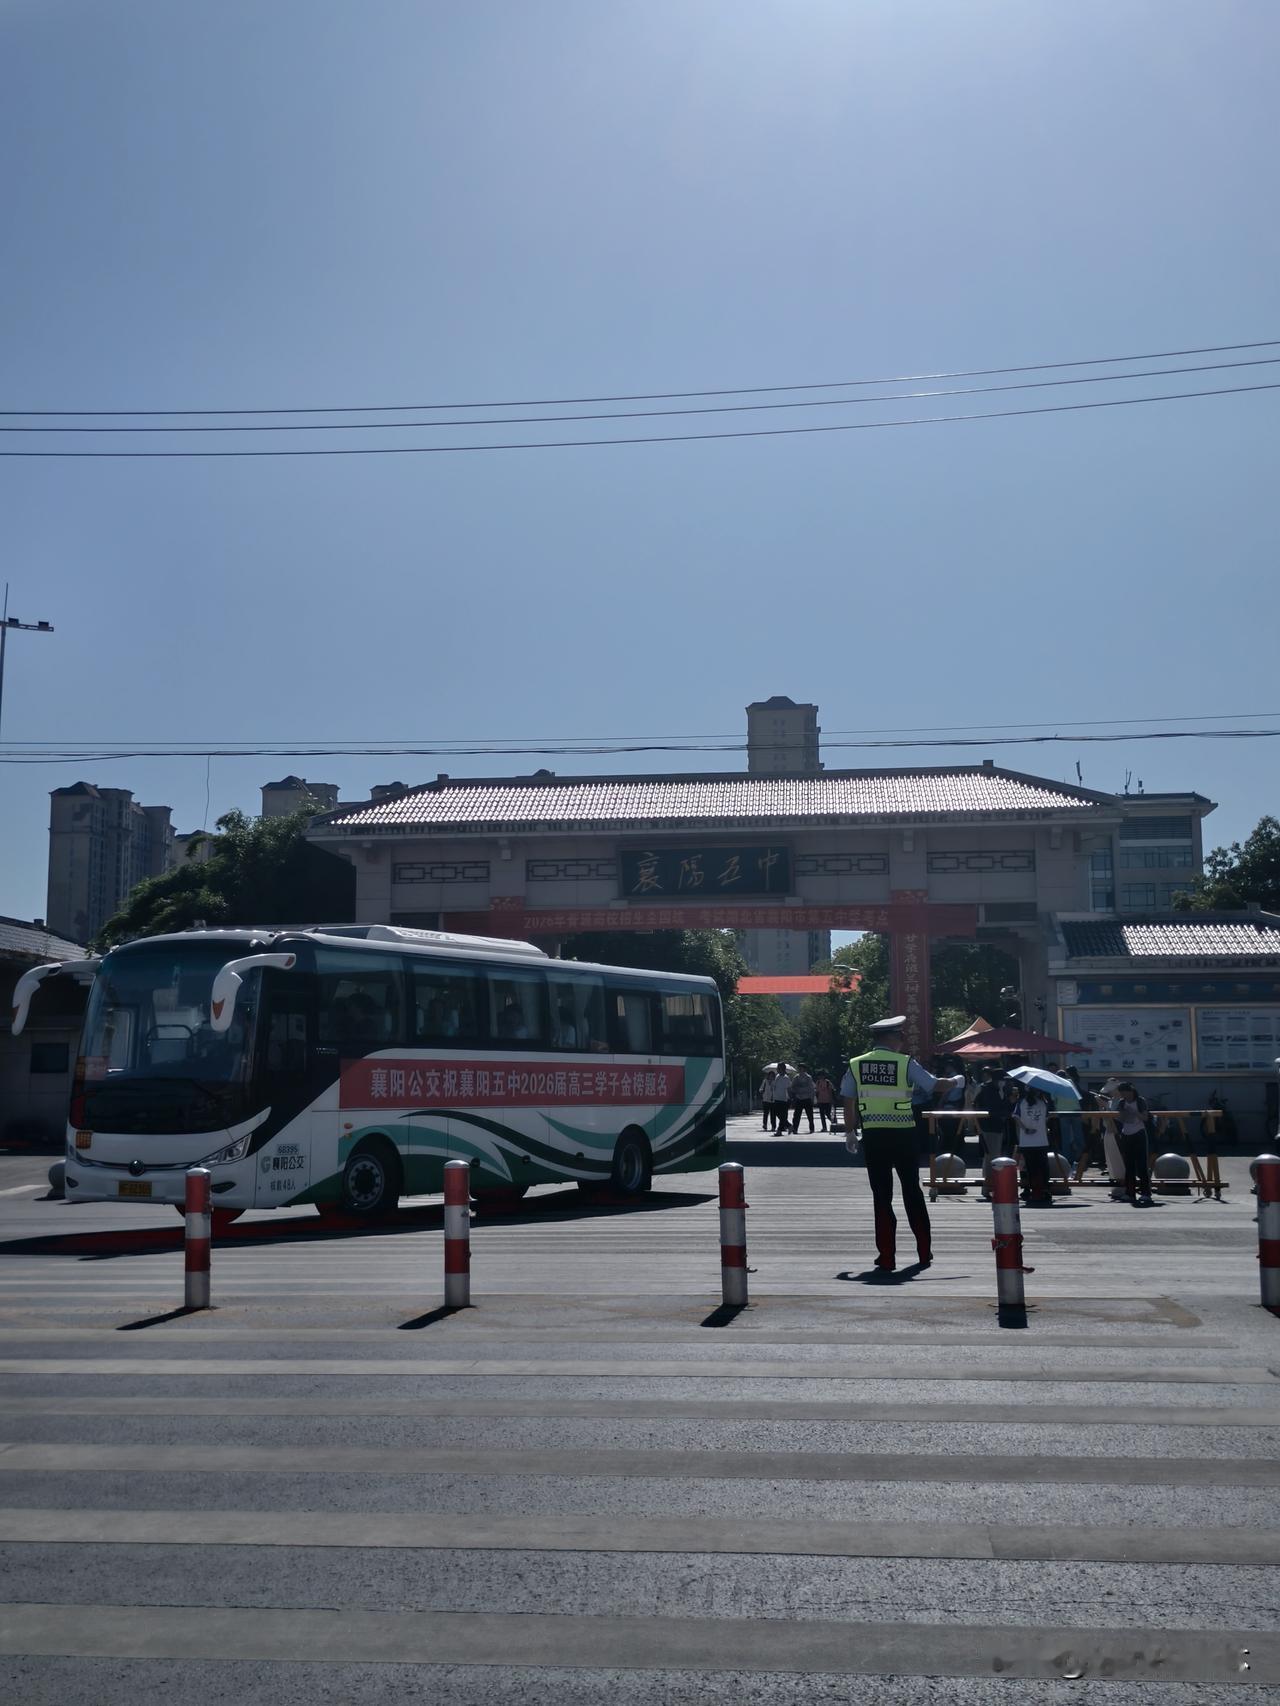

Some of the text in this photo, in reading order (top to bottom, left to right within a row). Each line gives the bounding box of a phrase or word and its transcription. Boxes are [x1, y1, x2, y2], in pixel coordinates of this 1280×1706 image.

[861, 1063, 896, 1074] 襄阳交警
[370, 1067, 668, 1099] 襄阳公交祝襄阳五中2026届高三学子金榜题名
[862, 1074, 895, 1083] POLICE
[273, 1155, 304, 1170] 襄阳公交
